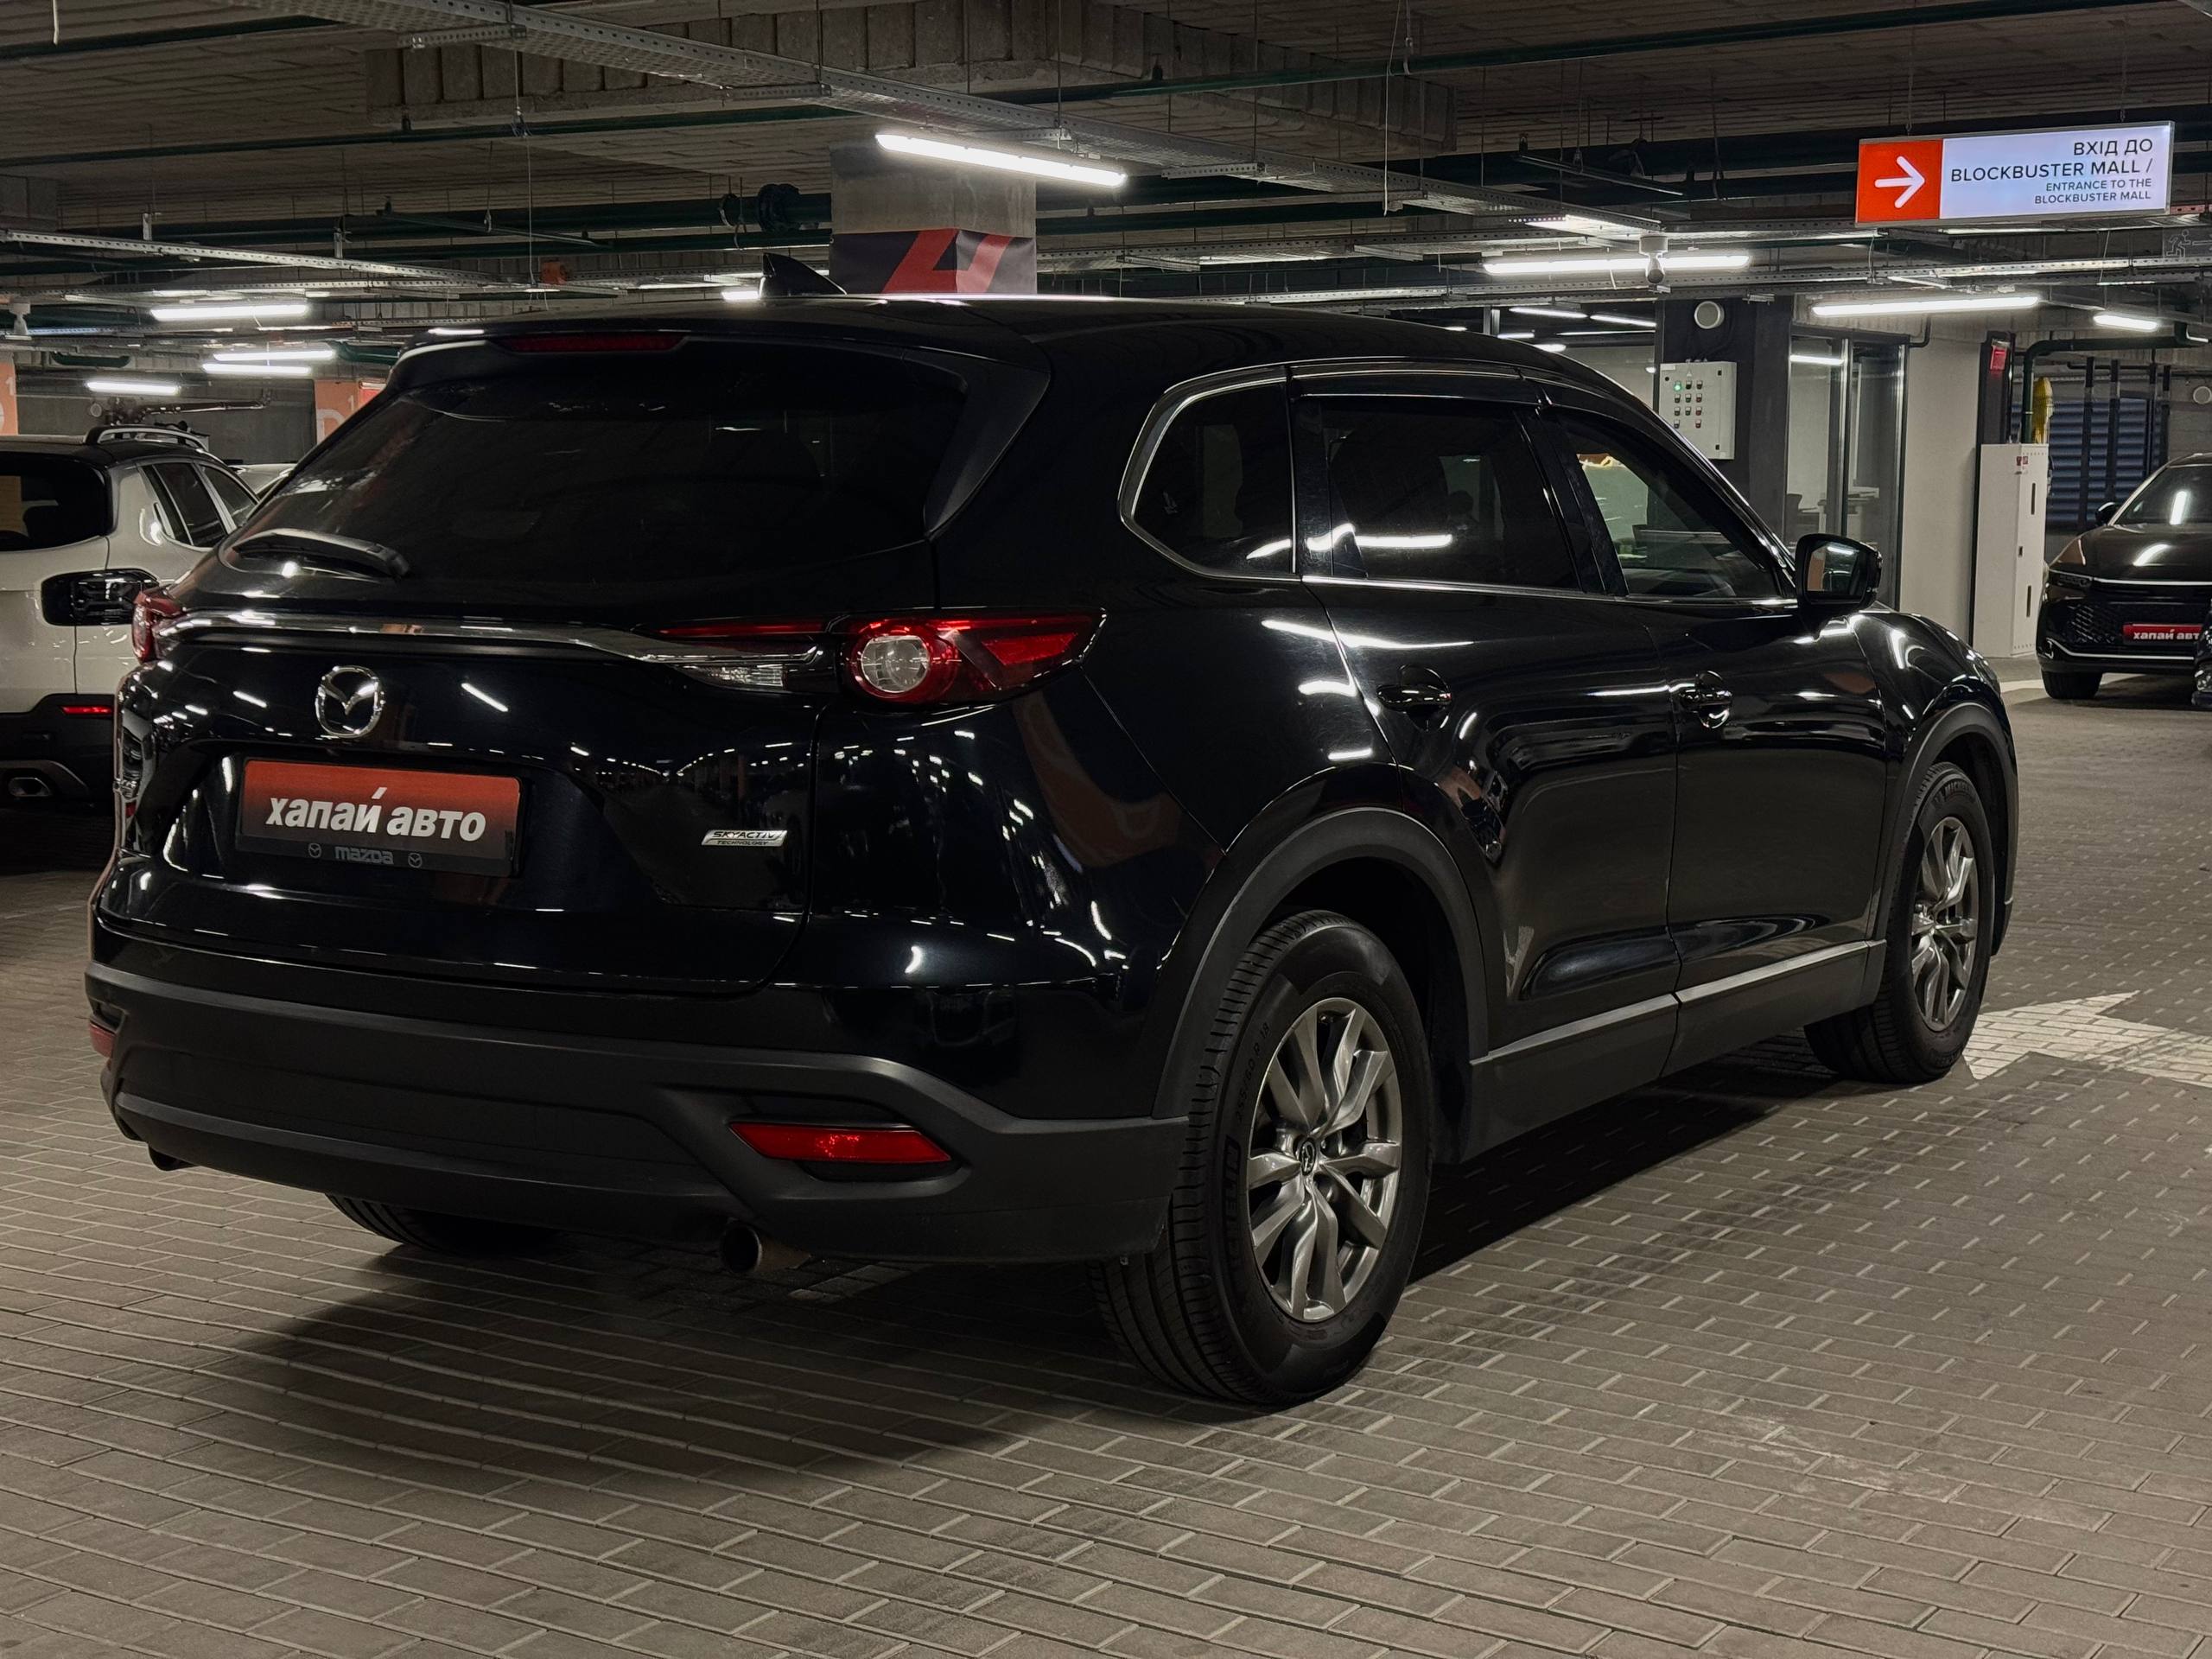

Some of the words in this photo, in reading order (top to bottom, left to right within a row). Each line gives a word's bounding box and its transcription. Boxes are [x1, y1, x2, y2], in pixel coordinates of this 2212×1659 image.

[2074, 140, 2118, 157] ВХІД
[2125, 138, 2153, 156] ДО
[1951, 162, 2084, 182] BLOCKBUSTER
[2090, 159, 2141, 175] MALL
[2145, 157, 2153, 173] /
[2045, 180, 2107, 193] ENTRANCE
[2110, 179, 2126, 190] TO
[2129, 178, 2152, 188] THE
[2034, 192, 2117, 205] BLOCKBUSTER
[2120, 191, 2151, 201] MALL
[265, 787, 388, 833] хапай
[386, 805, 486, 842] авто
[713, 830, 780, 839] SKYACTIV
[334, 845, 395, 865] mazda
